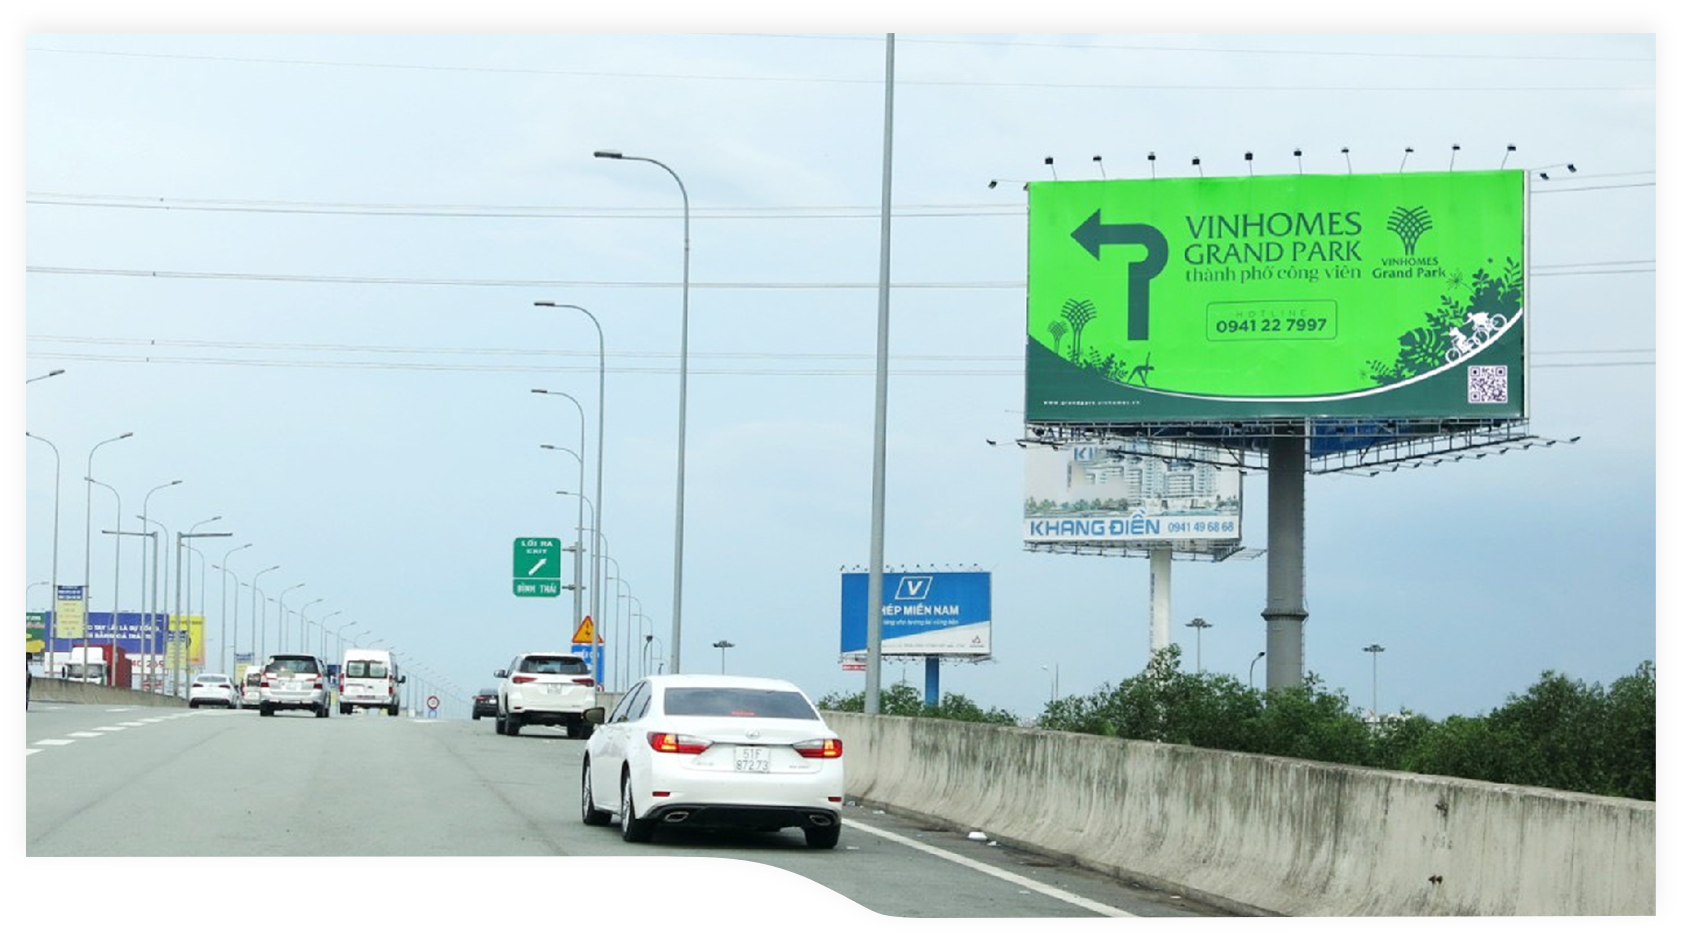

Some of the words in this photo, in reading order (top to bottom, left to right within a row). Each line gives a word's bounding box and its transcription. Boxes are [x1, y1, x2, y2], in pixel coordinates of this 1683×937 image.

[1185, 211, 1362, 240] VINHOMES
[1184, 241, 1284, 265] GRAND
[1292, 240, 1362, 262] PARK
[1381, 256, 1439, 267] VINHOMES
[1186, 266, 1236, 283] thành
[1241, 264, 1275, 284] phố
[1277, 264, 1319, 284] công
[1325, 264, 1362, 280] viên
[1372, 267, 1413, 279] Grand
[1417, 266, 1446, 278] Park
[1216, 320, 1256, 334] 0941
[1261, 318, 1282, 332] 22
[1286, 317, 1327, 332] 7997
[1030, 519, 1105, 536] KHANG
[1109, 508, 1160, 536] ĐIỀN
[1168, 521, 1191, 533] 0941
[1193, 521, 1206, 532] 49
[1207, 521, 1220, 532] 68
[1222, 521, 1234, 532] 68
[517, 582, 536, 593] BÌNH
[933, 605, 960, 616] NAM
[743, 748, 762, 759] 51F
